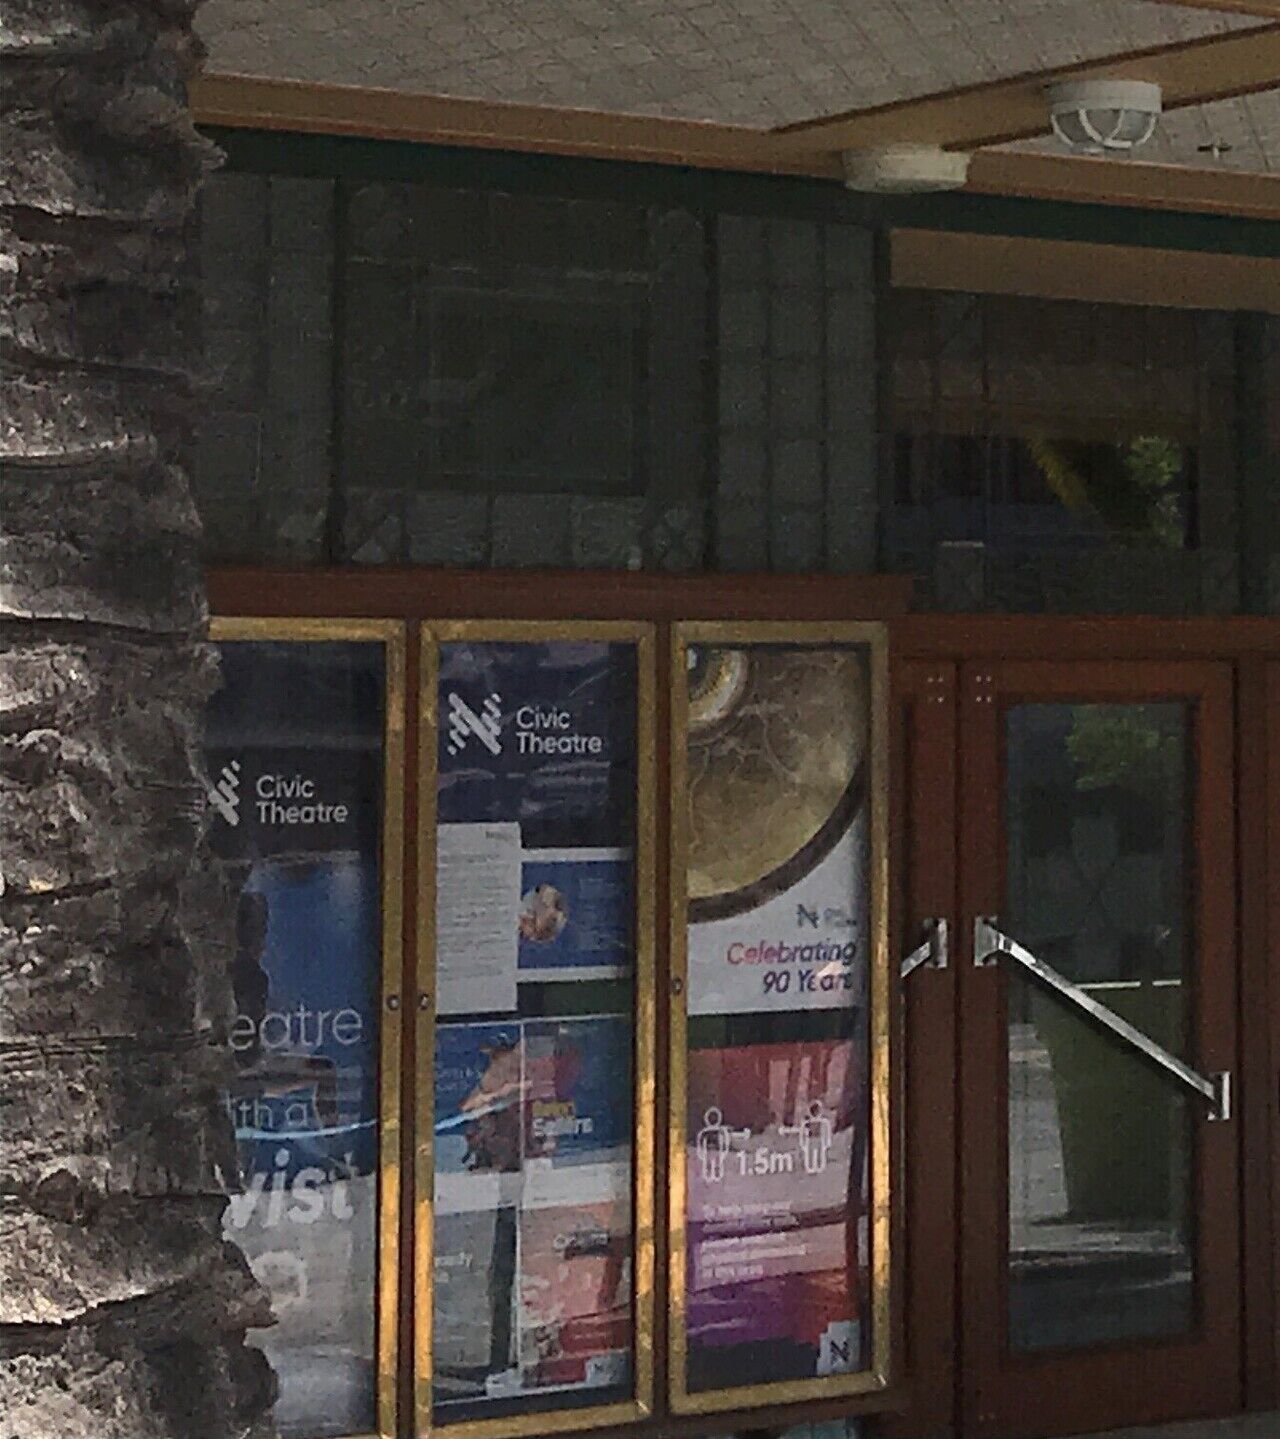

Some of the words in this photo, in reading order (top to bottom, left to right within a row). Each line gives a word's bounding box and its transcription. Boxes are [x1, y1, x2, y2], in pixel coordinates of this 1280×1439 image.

[516, 706, 570, 730] Civic
[516, 732, 602, 755] Theatre
[256, 775, 314, 799] Civic
[256, 802, 348, 825] Theatre
[726, 937, 857, 967] Celebrating
[762, 970, 790, 995] 90
[736, 1148, 793, 1176] 1.5m
